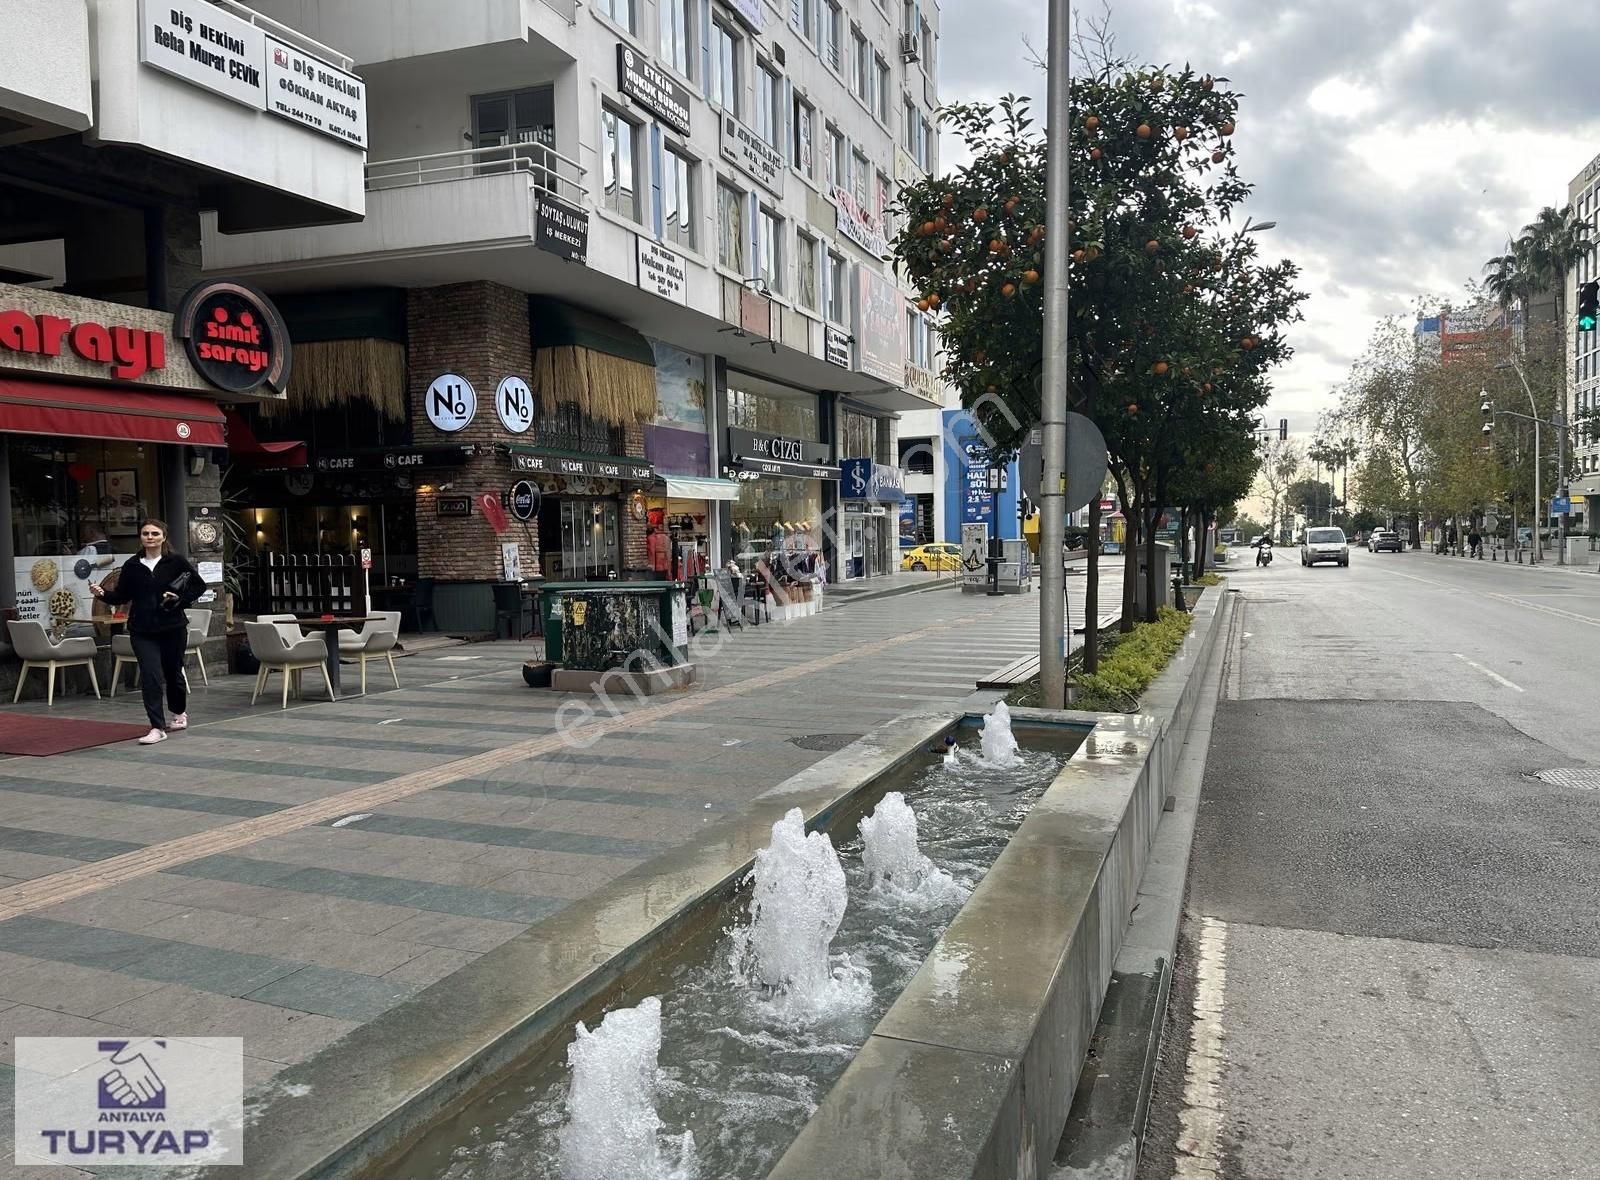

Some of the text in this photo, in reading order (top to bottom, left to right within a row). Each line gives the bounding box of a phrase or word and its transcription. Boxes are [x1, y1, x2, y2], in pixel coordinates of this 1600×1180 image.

[170, 9, 245, 57] DİŞ HEKİMİ
[154, 24, 260, 88] Reha Murat ÇEVİK
[293, 58, 315, 80] DİŞ
[318, 70, 360, 100] HEKİMİ
[643, 63, 673, 95] ETKİN
[279, 78, 357, 122] GÖKHAN AKTAŞ
[626, 67, 689, 121] HUKUK BÜROSU
[275, 101, 290, 113] TEL:
[554, 229, 581, 248] MERKEZİ
[199, 342, 269, 371] sarayı
[753, 438, 769, 456] B&Ç
[329, 458, 354, 469] CAFE
[398, 455, 423, 465] CAFE
[527, 458, 543, 469] CAFE
[569, 462, 583, 472] CAFE
[605, 465, 619, 475] CAFE
[638, 468, 650, 478] CAFE
